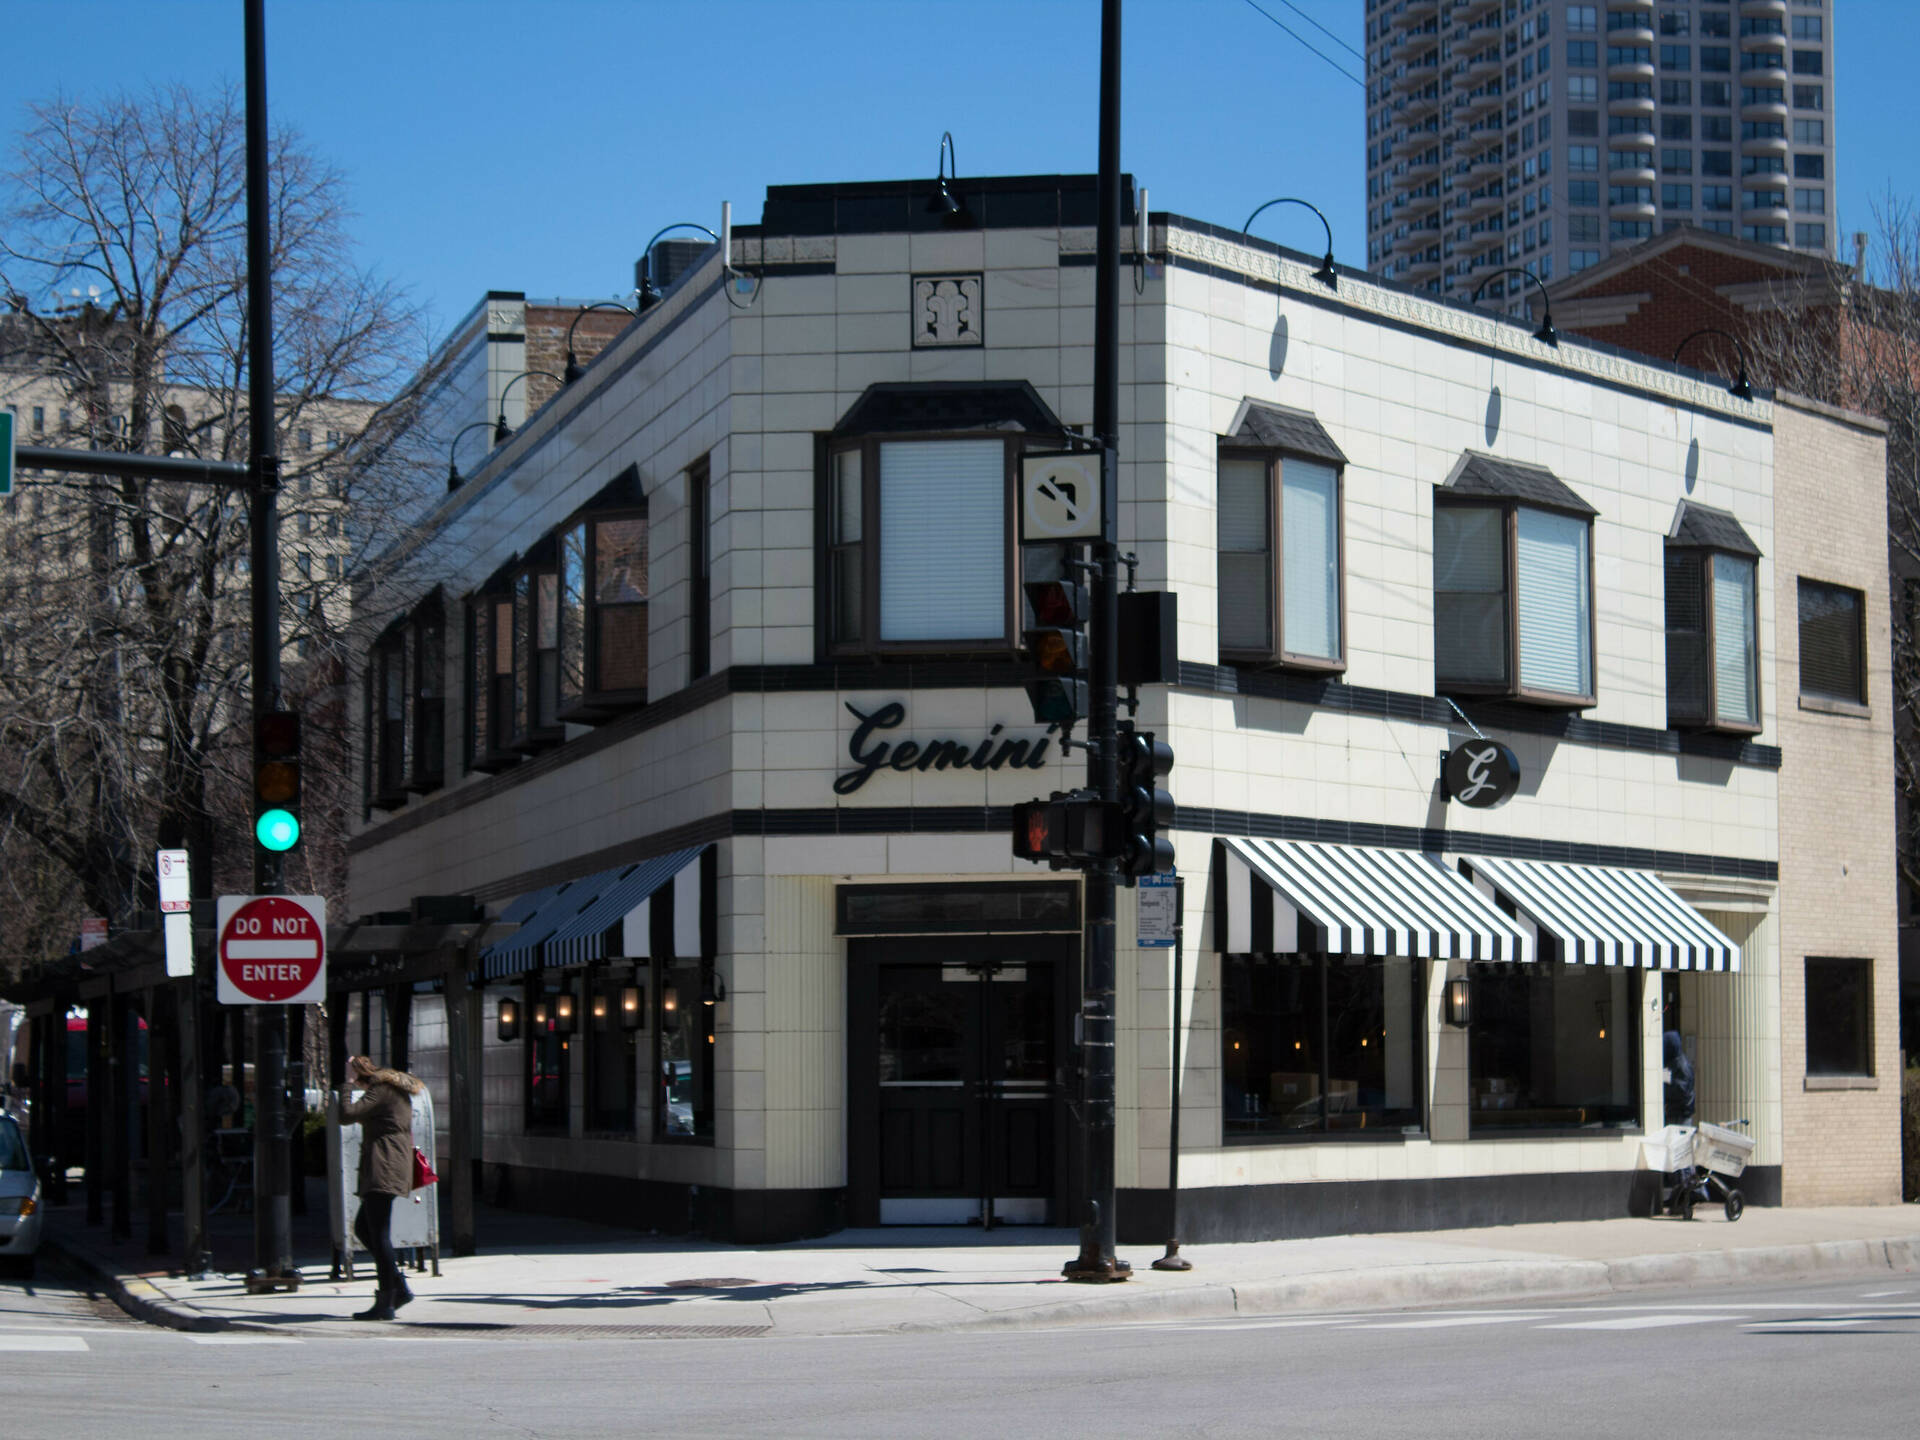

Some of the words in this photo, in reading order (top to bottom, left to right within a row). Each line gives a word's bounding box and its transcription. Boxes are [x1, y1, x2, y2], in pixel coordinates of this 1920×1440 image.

[833, 701, 1059, 795] Gemini
[1459, 747, 1498, 801] G
[235, 917, 261, 935] DO
[273, 917, 309, 935] NOT
[242, 965, 301, 981] ENTER
